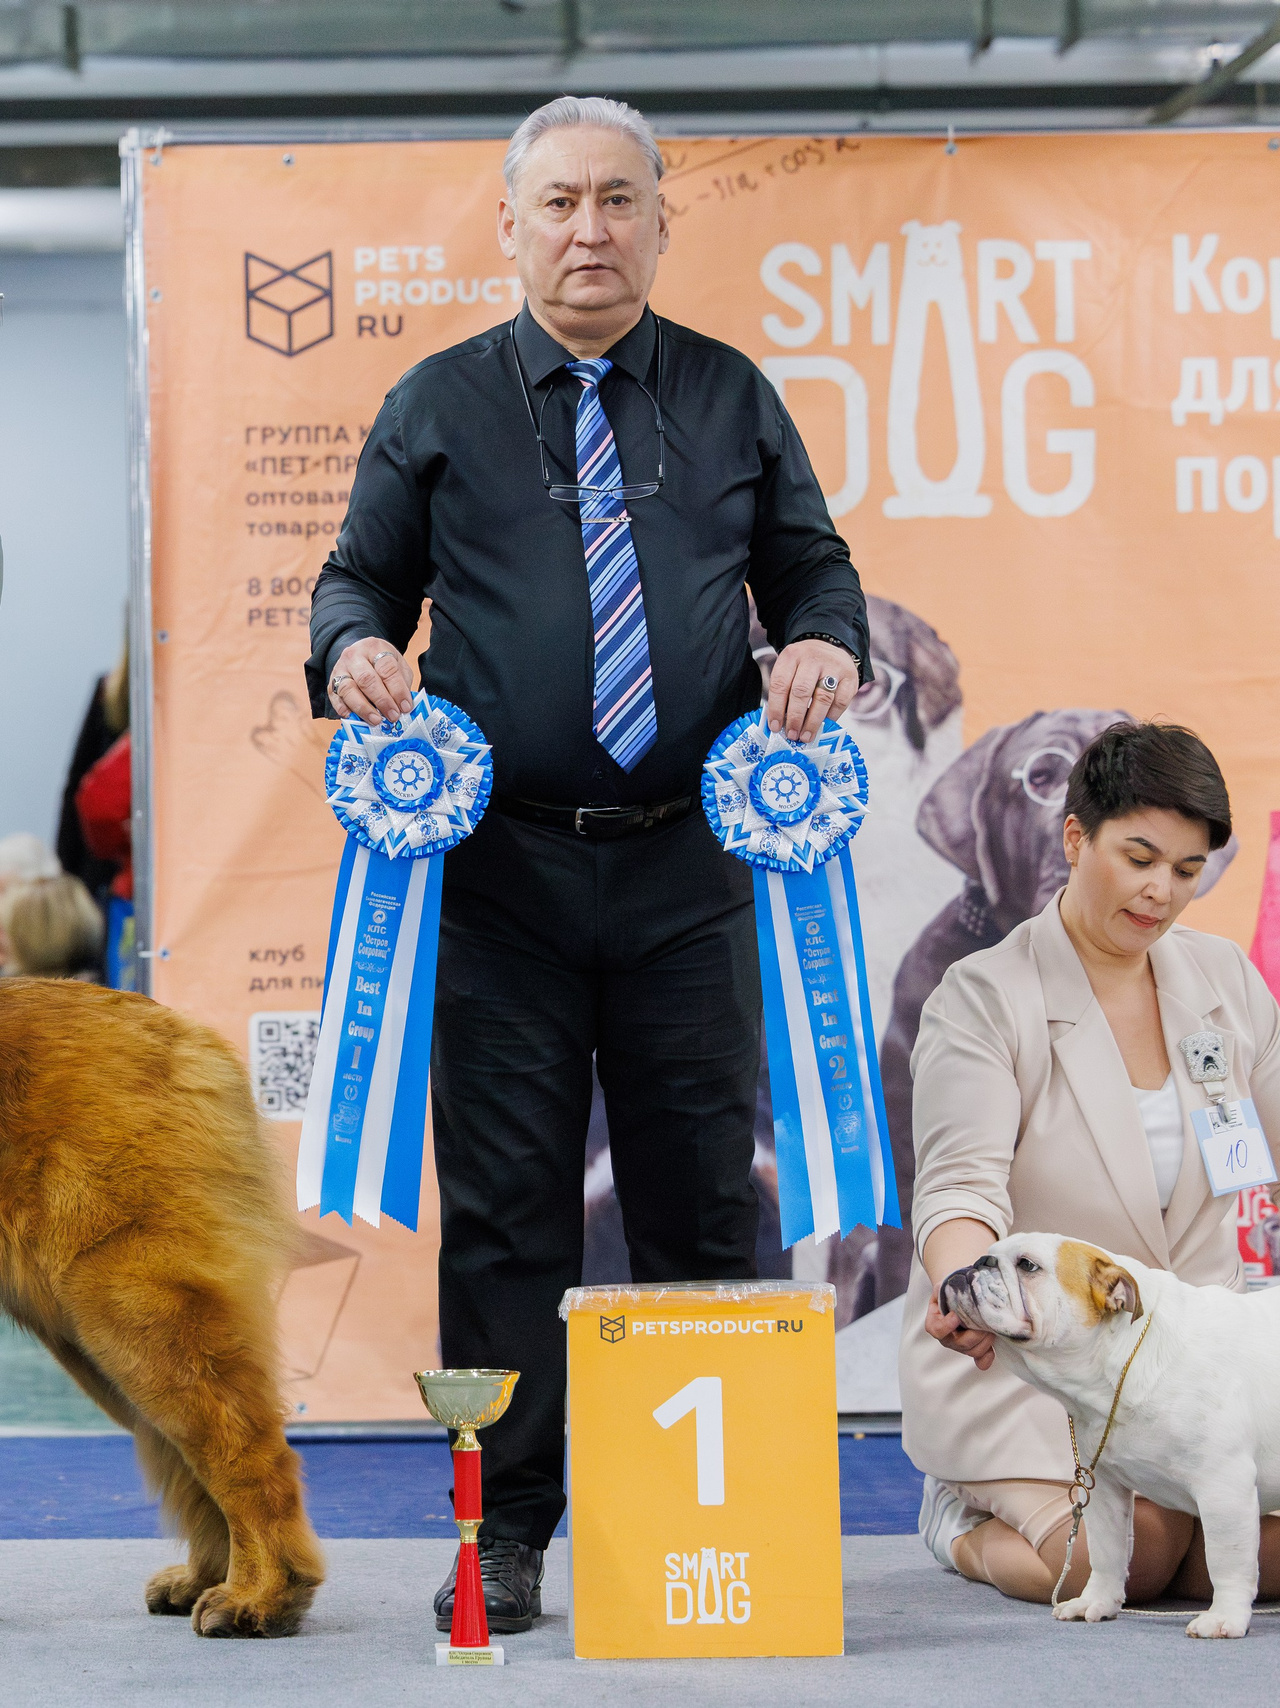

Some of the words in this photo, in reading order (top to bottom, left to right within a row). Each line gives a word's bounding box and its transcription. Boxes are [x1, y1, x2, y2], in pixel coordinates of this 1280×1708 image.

[354, 245, 446, 273] PETS
[354, 276, 521, 307] PRODUCT
[759, 219, 1092, 349] SMART
[1171, 232, 1280, 340] Ко
[357, 314, 404, 338] RU
[1170, 356, 1280, 427] дл
[245, 425, 350, 445] ГРУППА
[761, 349, 1097, 519] DOG
[1175, 455, 1280, 540] по
[246, 520, 342, 539] товаро
[248, 576, 261, 597] 8
[367, 924, 387, 935] КЛС
[805, 935, 826, 946] КЛС
[249, 944, 305, 967] клуб
[249, 977, 293, 993] для
[355, 975, 381, 996] Best
[357, 1000, 373, 1016] In
[811, 989, 839, 1007] Best
[348, 1020, 375, 1043] Group
[821, 1012, 838, 1027] In
[819, 1033, 848, 1050] Group
[350, 1044, 362, 1070] 1
[828, 1055, 847, 1080] 2
[1225, 1139, 1248, 1174] 10
[652, 1376, 725, 1506] 1
[664, 1547, 750, 1581] SMART
[665, 1580, 751, 1625] DOG
